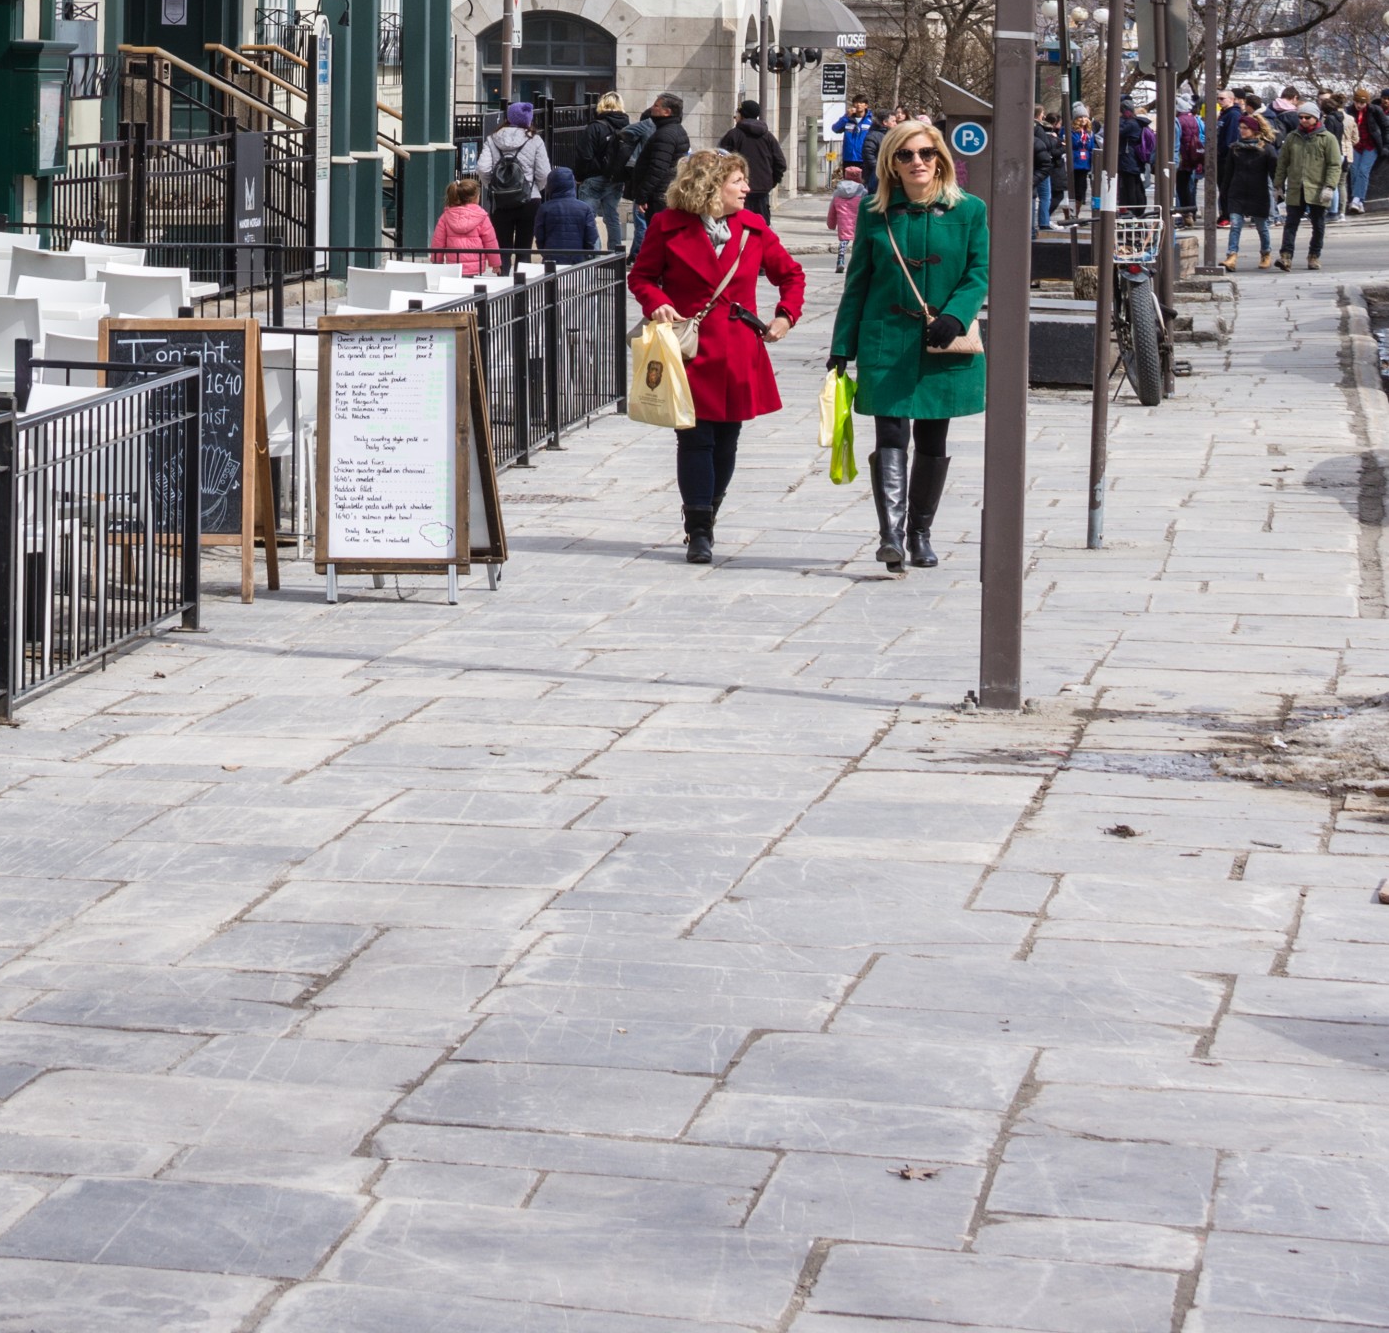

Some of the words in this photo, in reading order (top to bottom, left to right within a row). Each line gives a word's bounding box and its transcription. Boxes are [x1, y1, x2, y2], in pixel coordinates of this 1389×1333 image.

[205, 373, 242, 395] 1640
[370, 391, 389, 399] Burger
[383, 444, 396, 452] Soup
[376, 466, 393, 475] grilled
